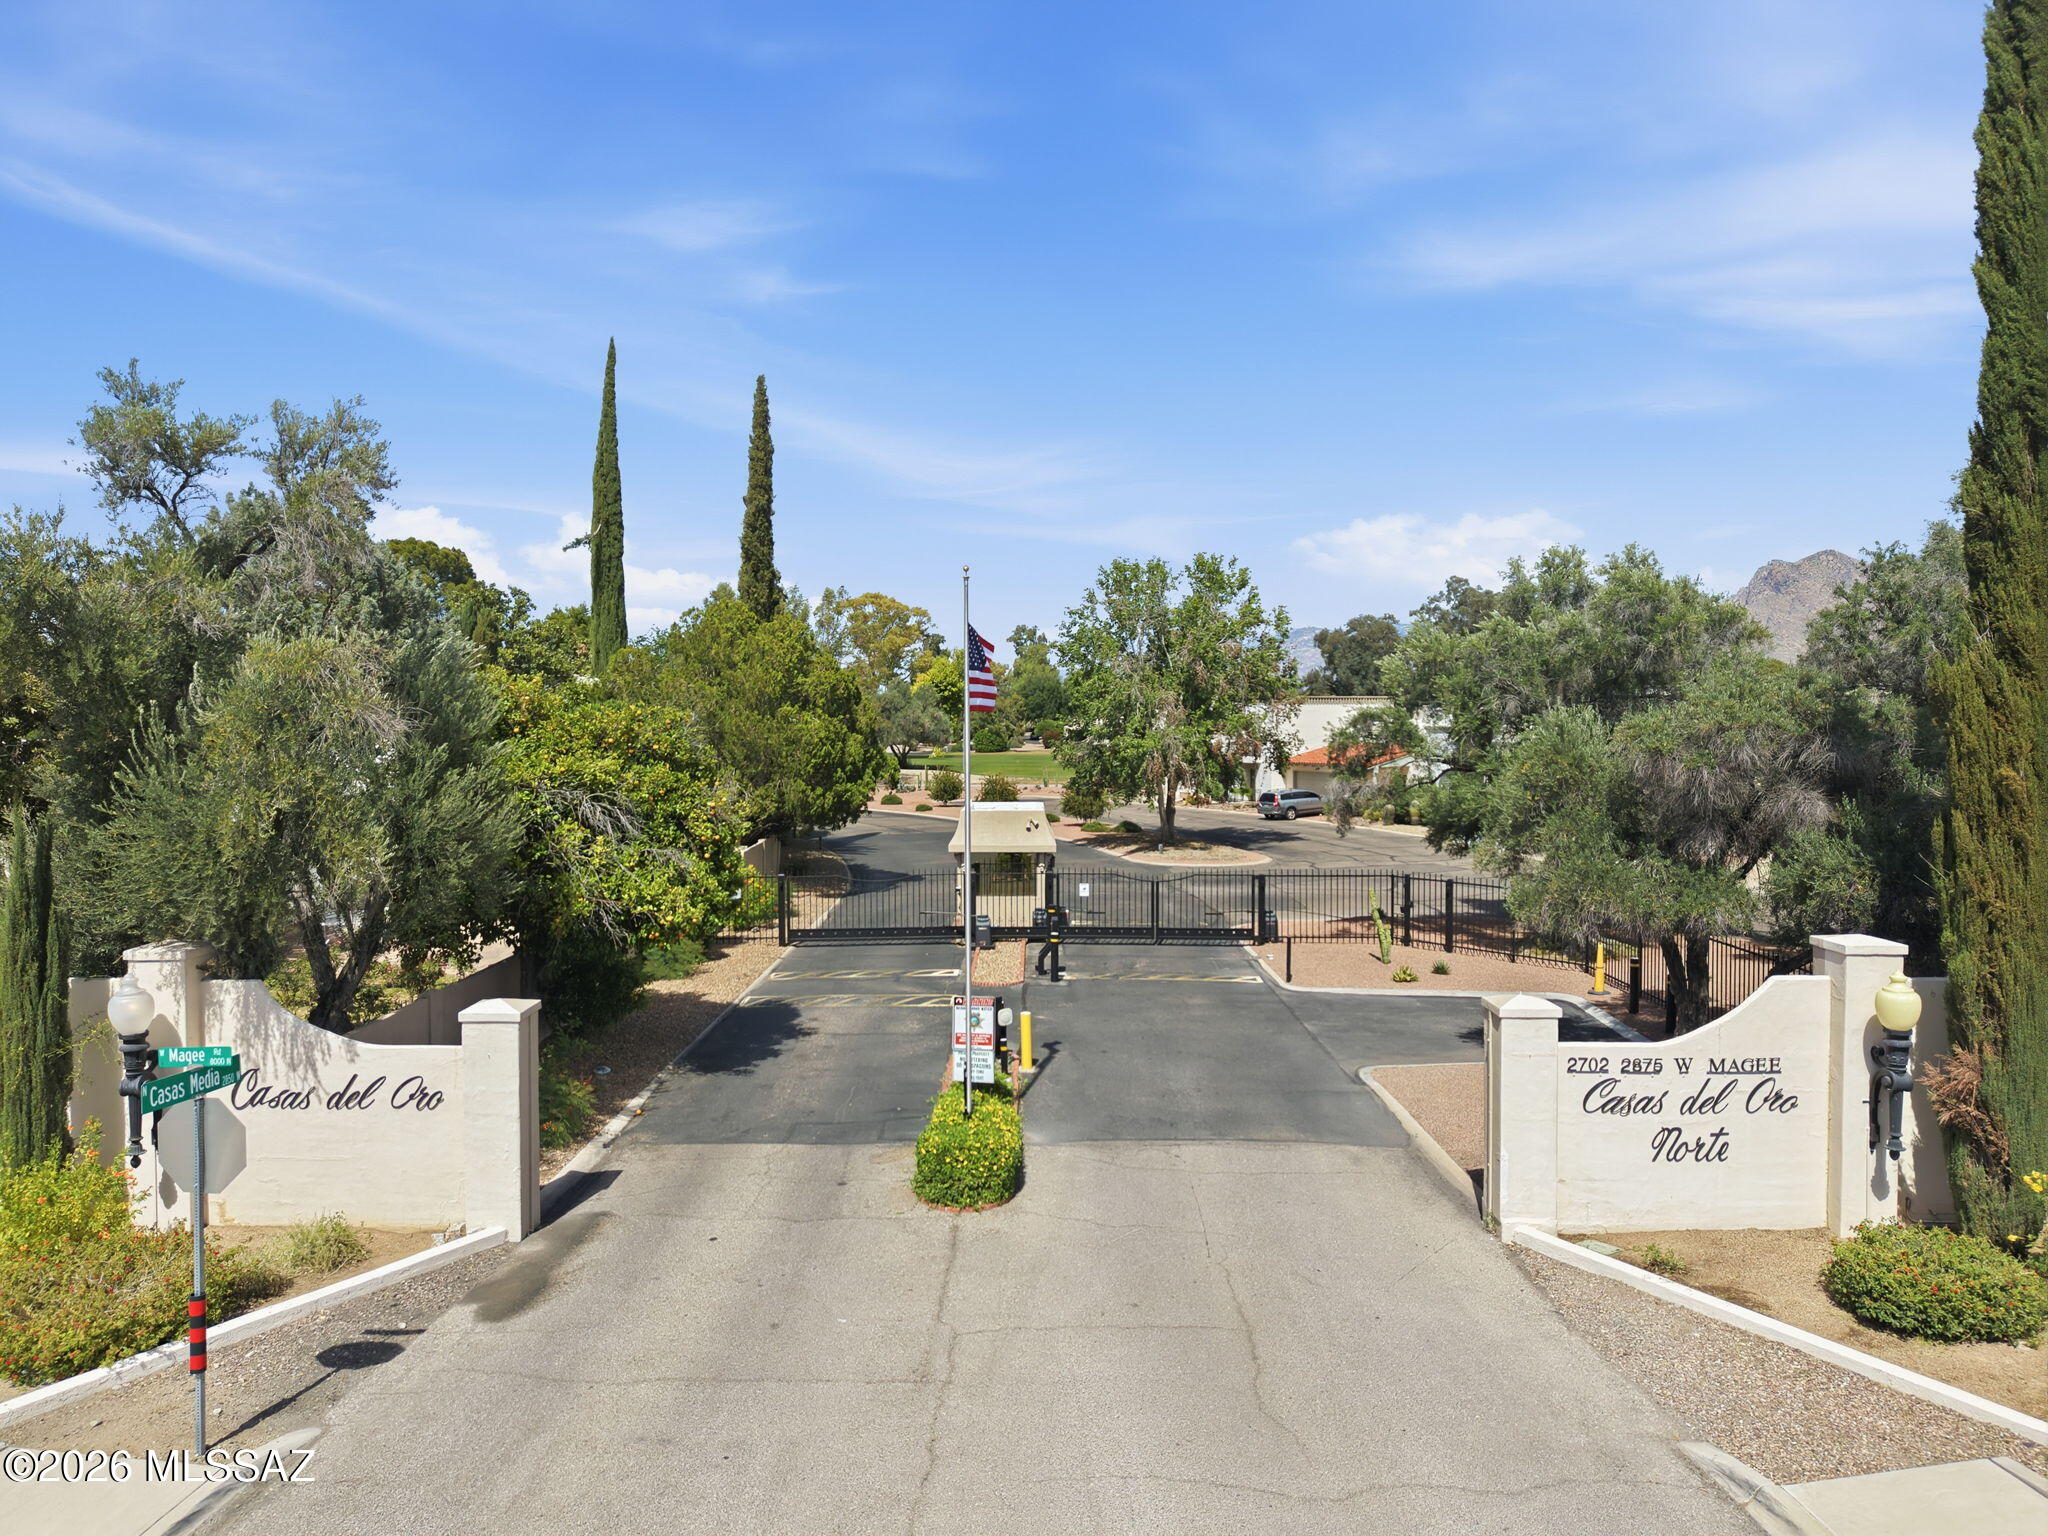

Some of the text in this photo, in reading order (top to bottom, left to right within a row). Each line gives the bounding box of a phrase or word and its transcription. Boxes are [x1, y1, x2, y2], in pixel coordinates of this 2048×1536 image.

[168, 1049, 205, 1064] Magee
[1566, 1057, 1782, 1074] 2702 2875 W MAGEE
[142, 1086, 147, 1096] N
[149, 1082, 185, 1107] Casas
[190, 1069, 220, 1094] Media
[231, 1069, 444, 1112] Casas del Oro
[1582, 1077, 1799, 1117] Casas del Oro
[1651, 1126, 1730, 1163] Norte
